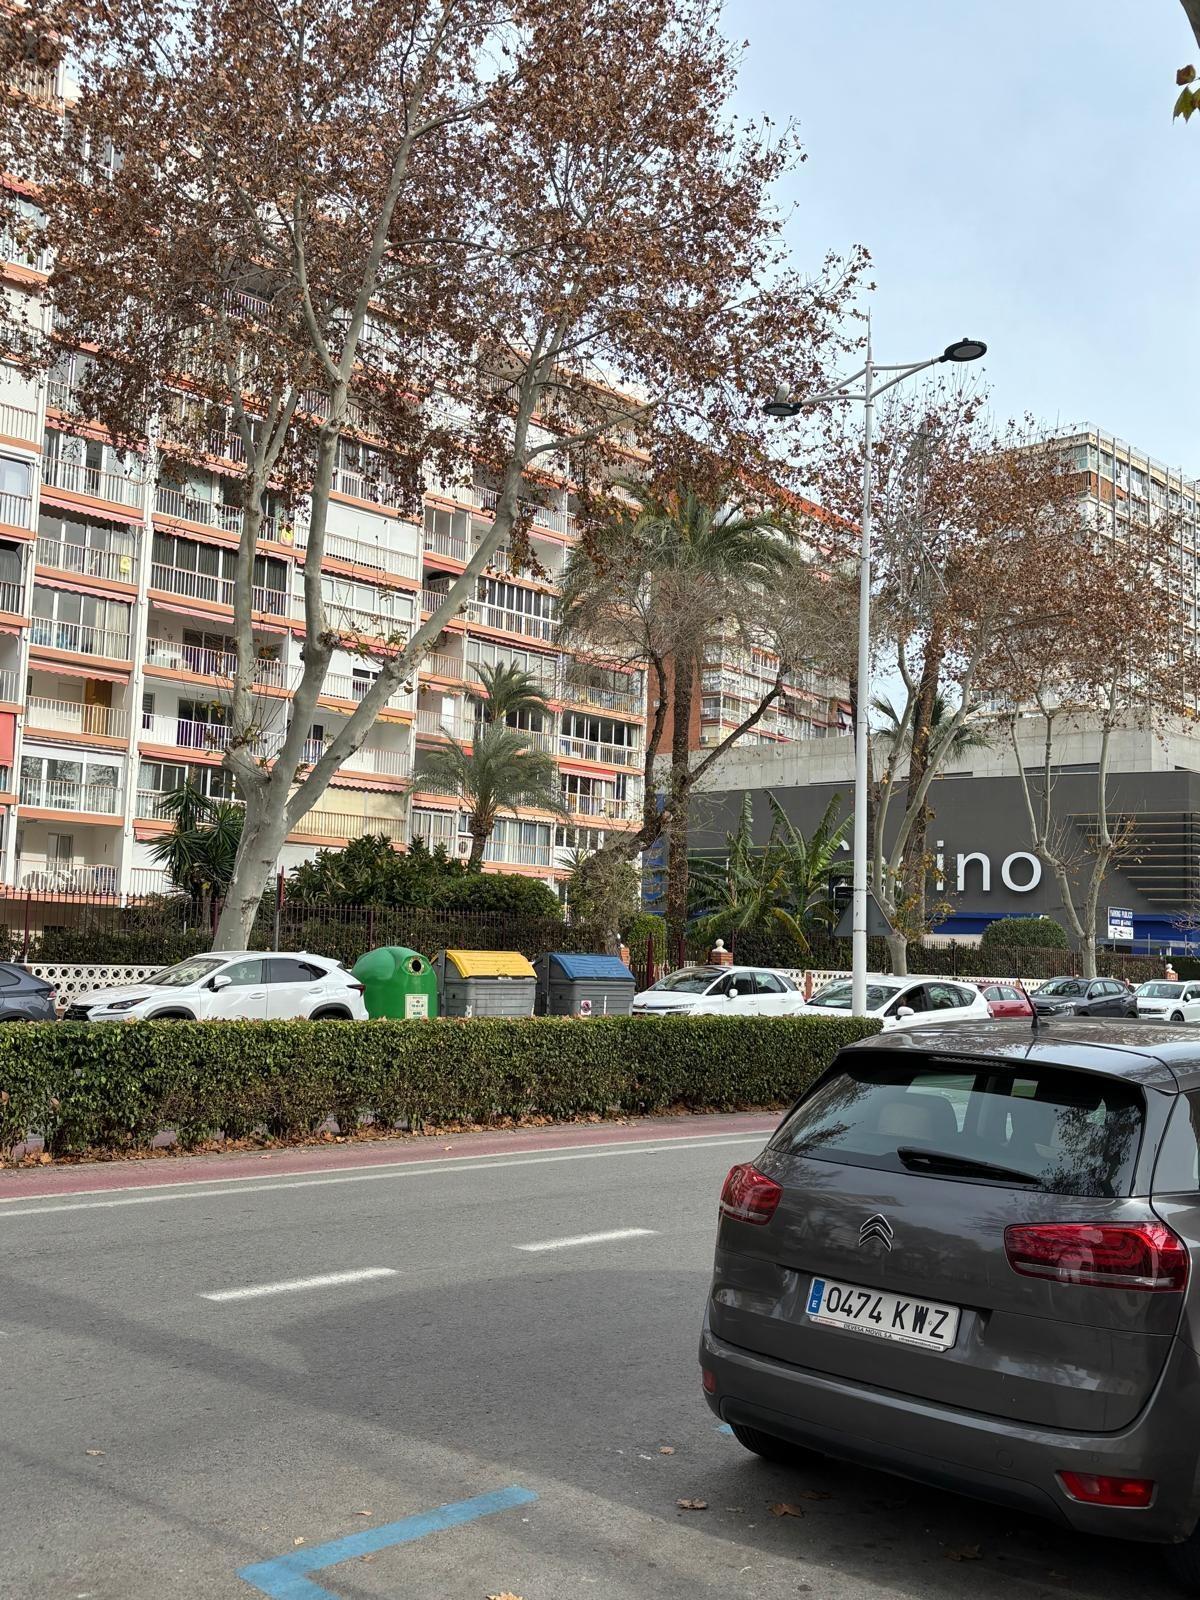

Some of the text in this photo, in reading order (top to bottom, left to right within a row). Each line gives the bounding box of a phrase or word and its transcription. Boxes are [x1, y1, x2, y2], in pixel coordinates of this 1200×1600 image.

[811, 1300, 818, 1308] E
[826, 1286, 950, 1340] 0474 KWZ
